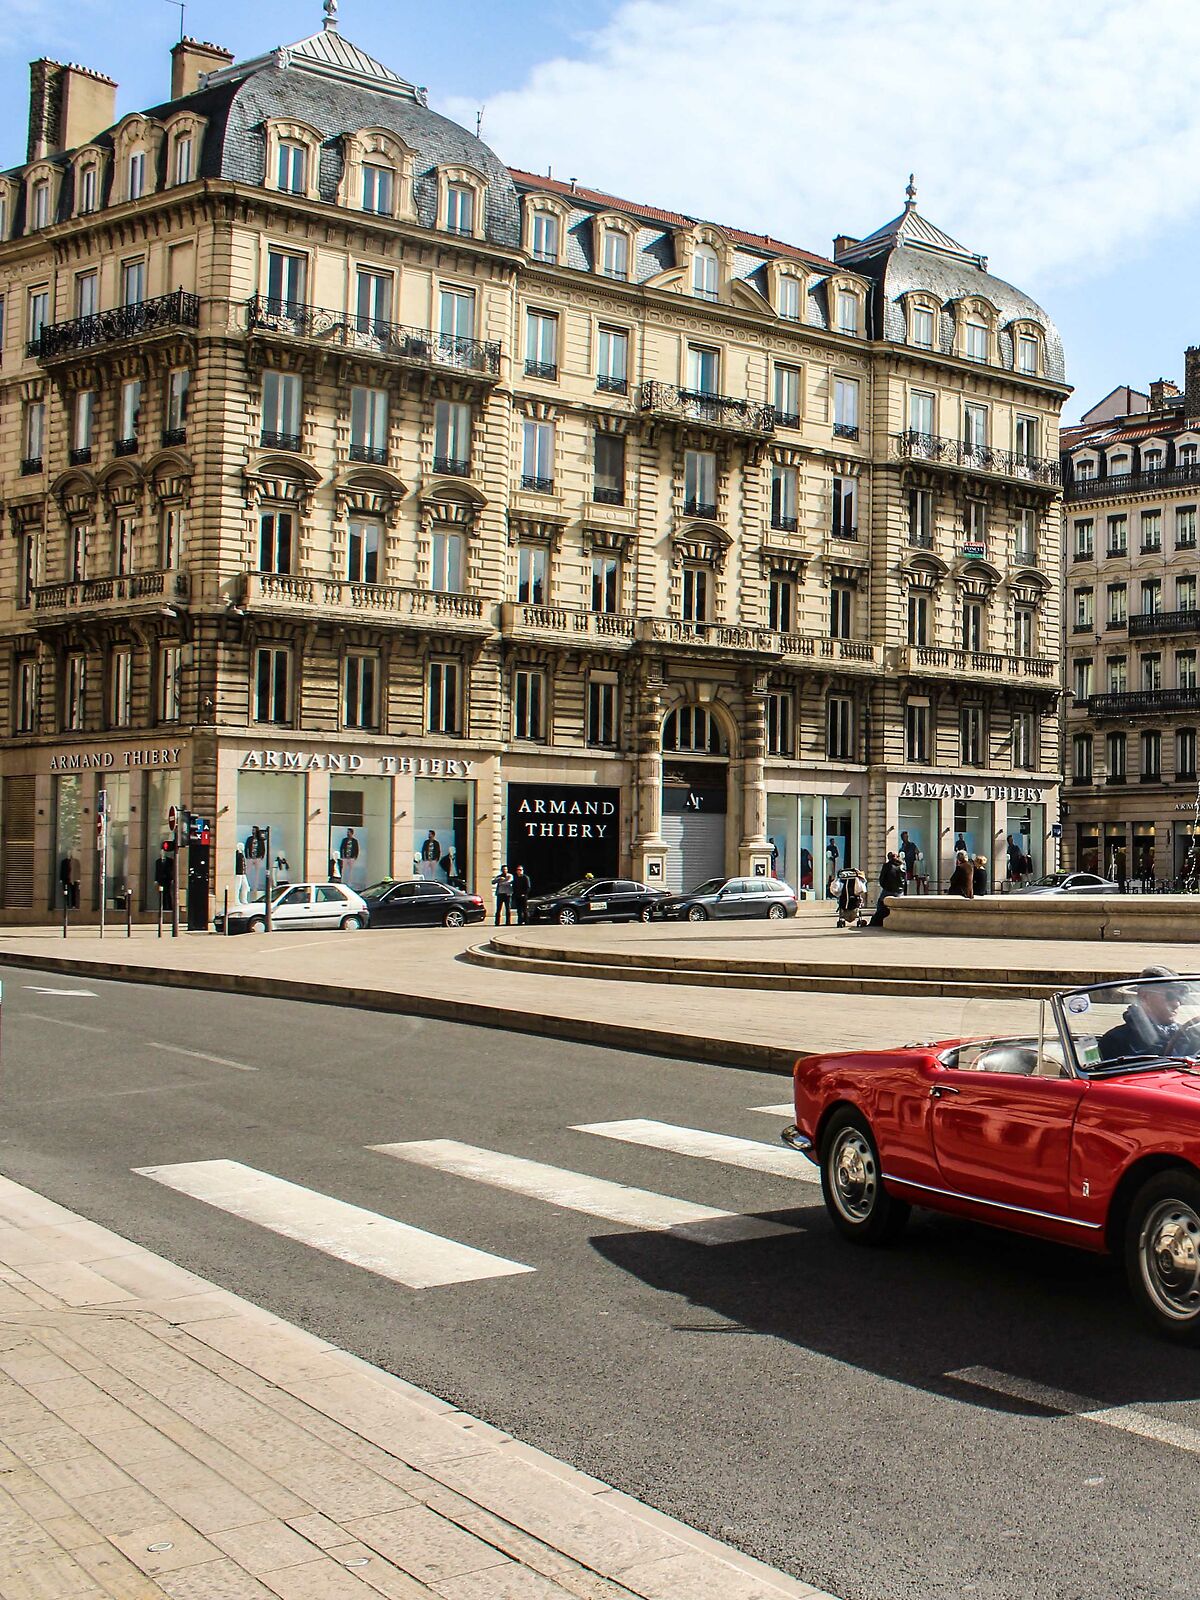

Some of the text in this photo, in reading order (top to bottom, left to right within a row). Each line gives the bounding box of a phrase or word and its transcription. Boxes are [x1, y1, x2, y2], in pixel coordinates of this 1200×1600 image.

[50, 748, 180, 769] ARMAND THIERY
[244, 750, 475, 776] ARMAND THIERY
[902, 782, 1045, 802] ARMAND THIERY
[518, 799, 615, 815] ARMAND
[525, 822, 607, 838] THIERY
